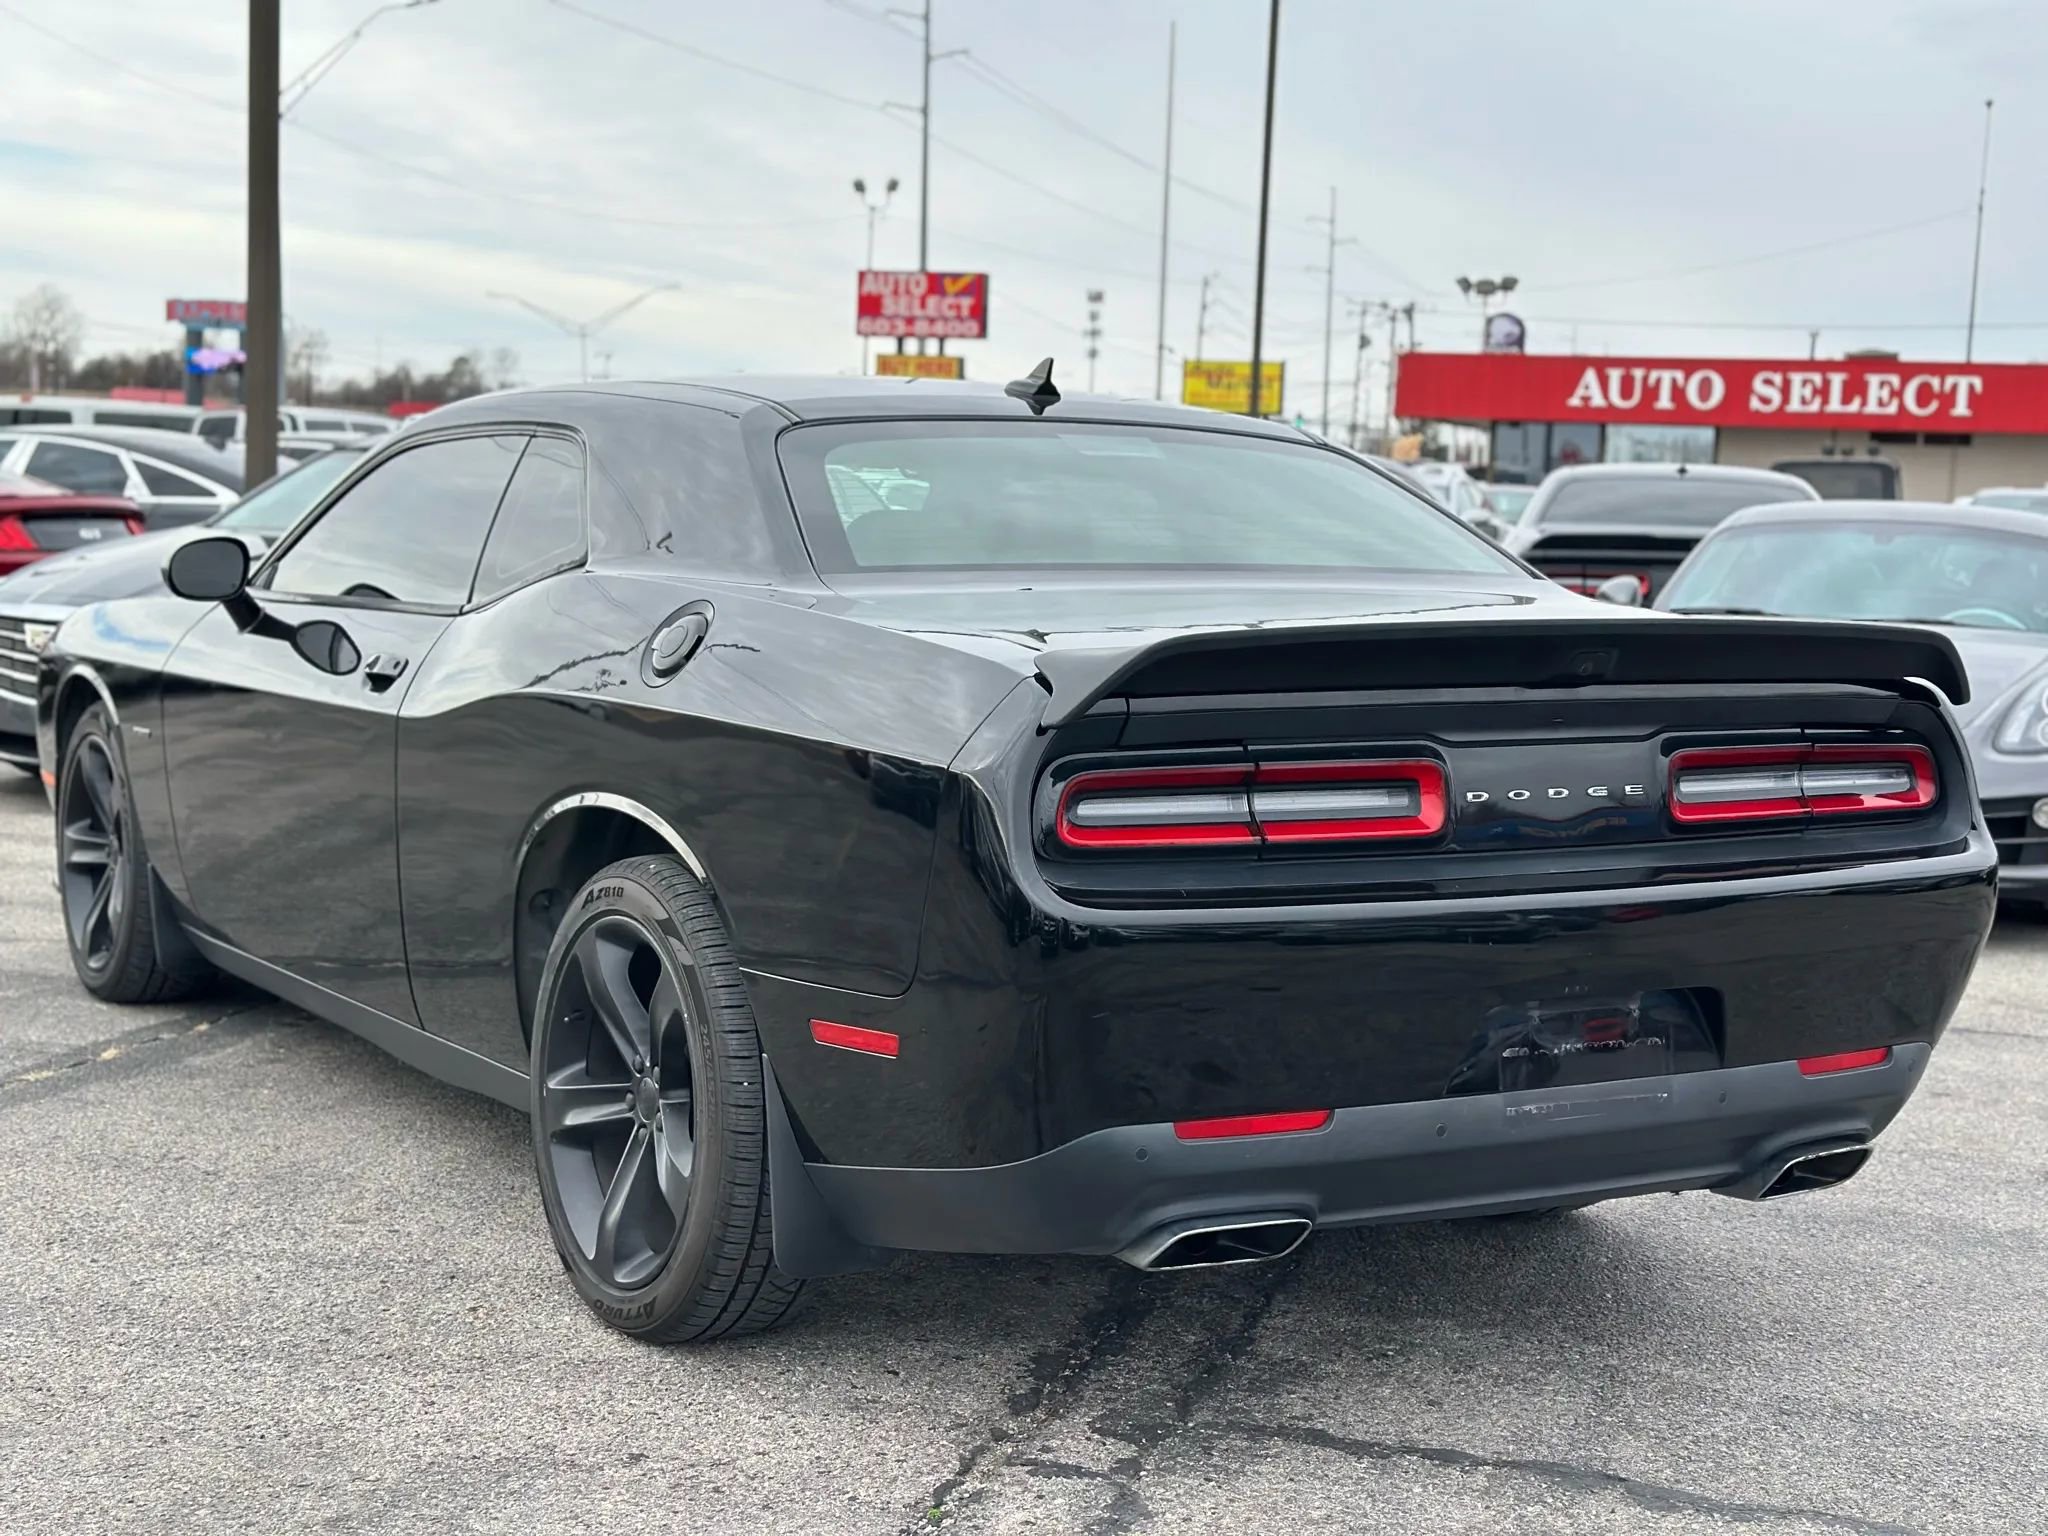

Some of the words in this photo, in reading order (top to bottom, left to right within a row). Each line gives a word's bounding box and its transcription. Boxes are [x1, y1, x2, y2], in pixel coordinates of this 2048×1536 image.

[861, 272, 928, 296] AUTO
[881, 294, 975, 319] SELECT
[1566, 366, 1726, 411] AUTO
[1749, 370, 1983, 417] SELECT
[1466, 784, 1644, 802] DODGE
[581, 887, 624, 910] AZ810
[594, 1295, 658, 1320] ATTURO
